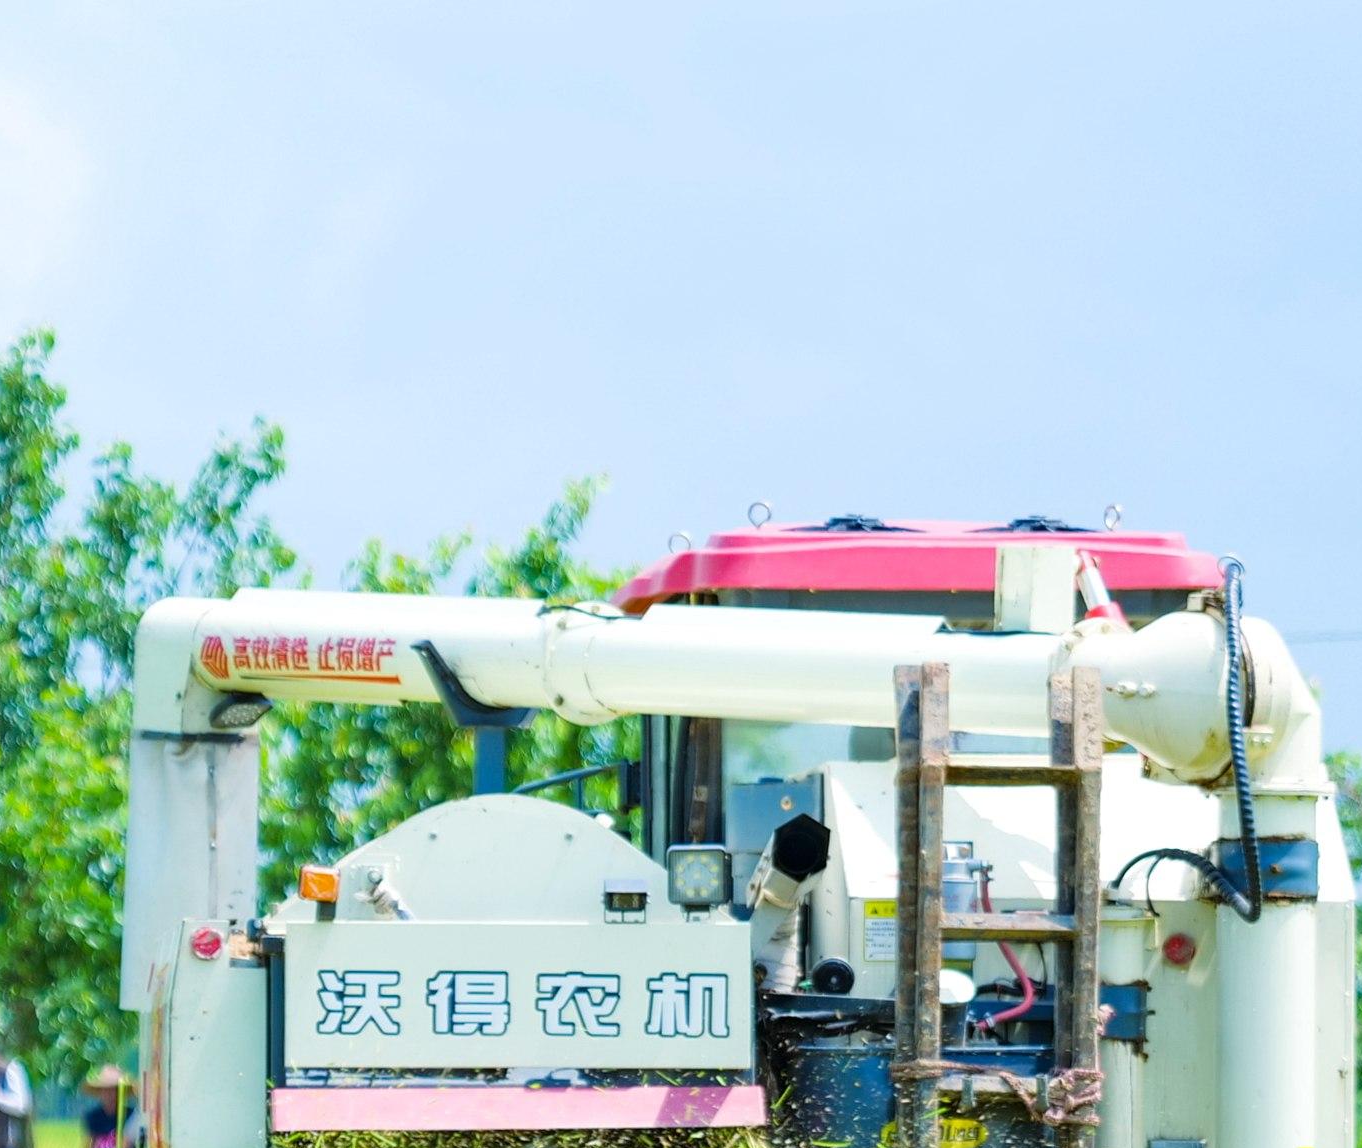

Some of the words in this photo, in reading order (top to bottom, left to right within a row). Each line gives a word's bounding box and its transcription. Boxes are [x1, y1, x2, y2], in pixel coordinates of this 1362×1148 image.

[317, 637, 396, 672] 止损增产
[317, 970, 729, 1038] 沃得农机
